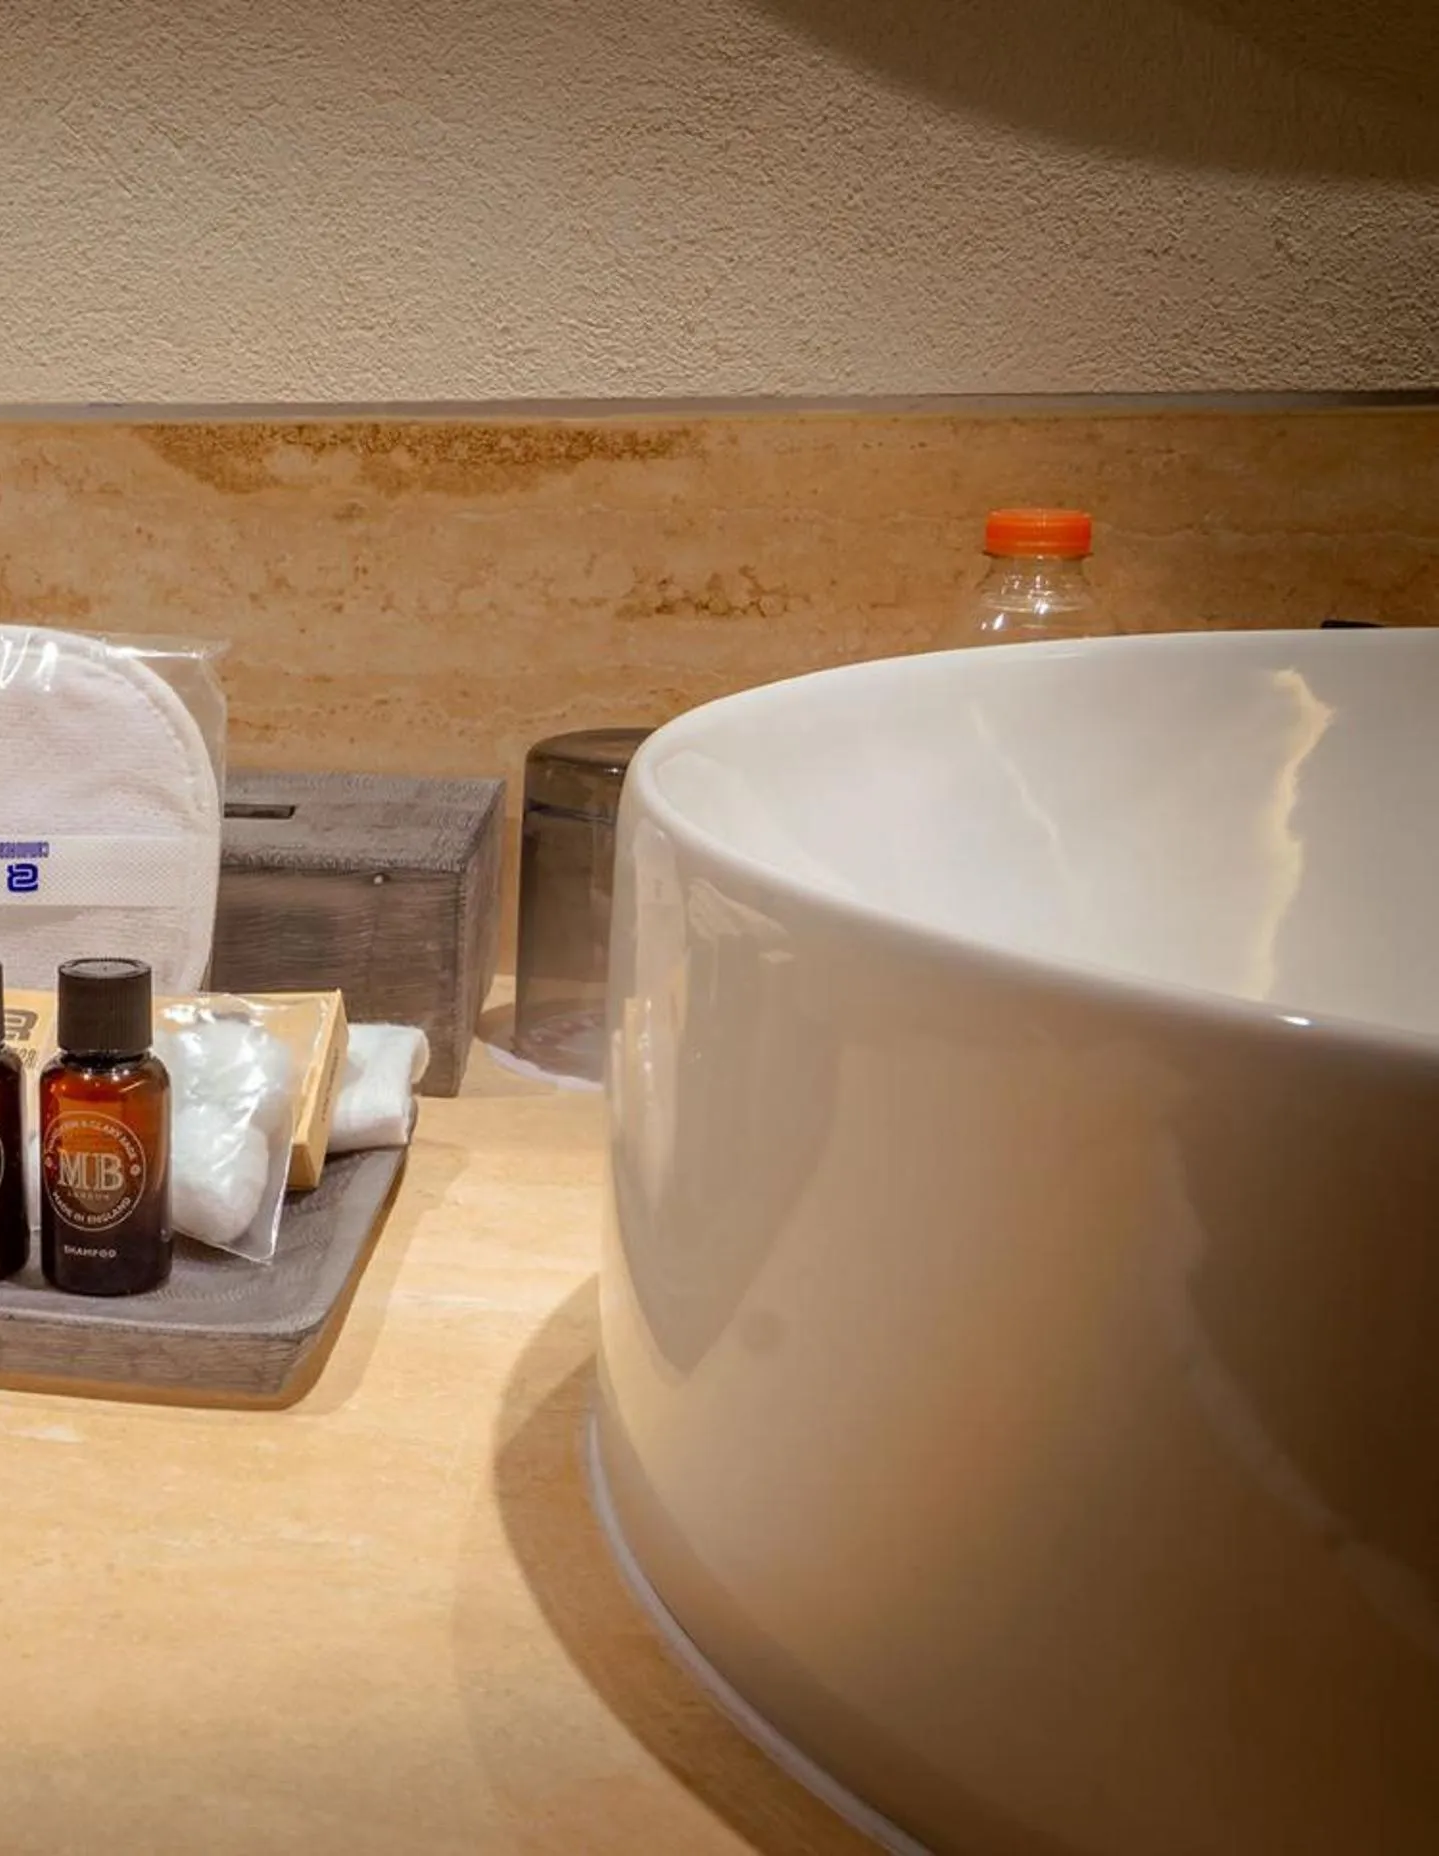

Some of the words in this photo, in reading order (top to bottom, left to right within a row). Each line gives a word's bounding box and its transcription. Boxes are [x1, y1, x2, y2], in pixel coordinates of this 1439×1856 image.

[57, 1148, 125, 1192] MB
[86, 1196, 131, 1225] ENGLAND
[63, 1244, 117, 1259] SHAMPOO
